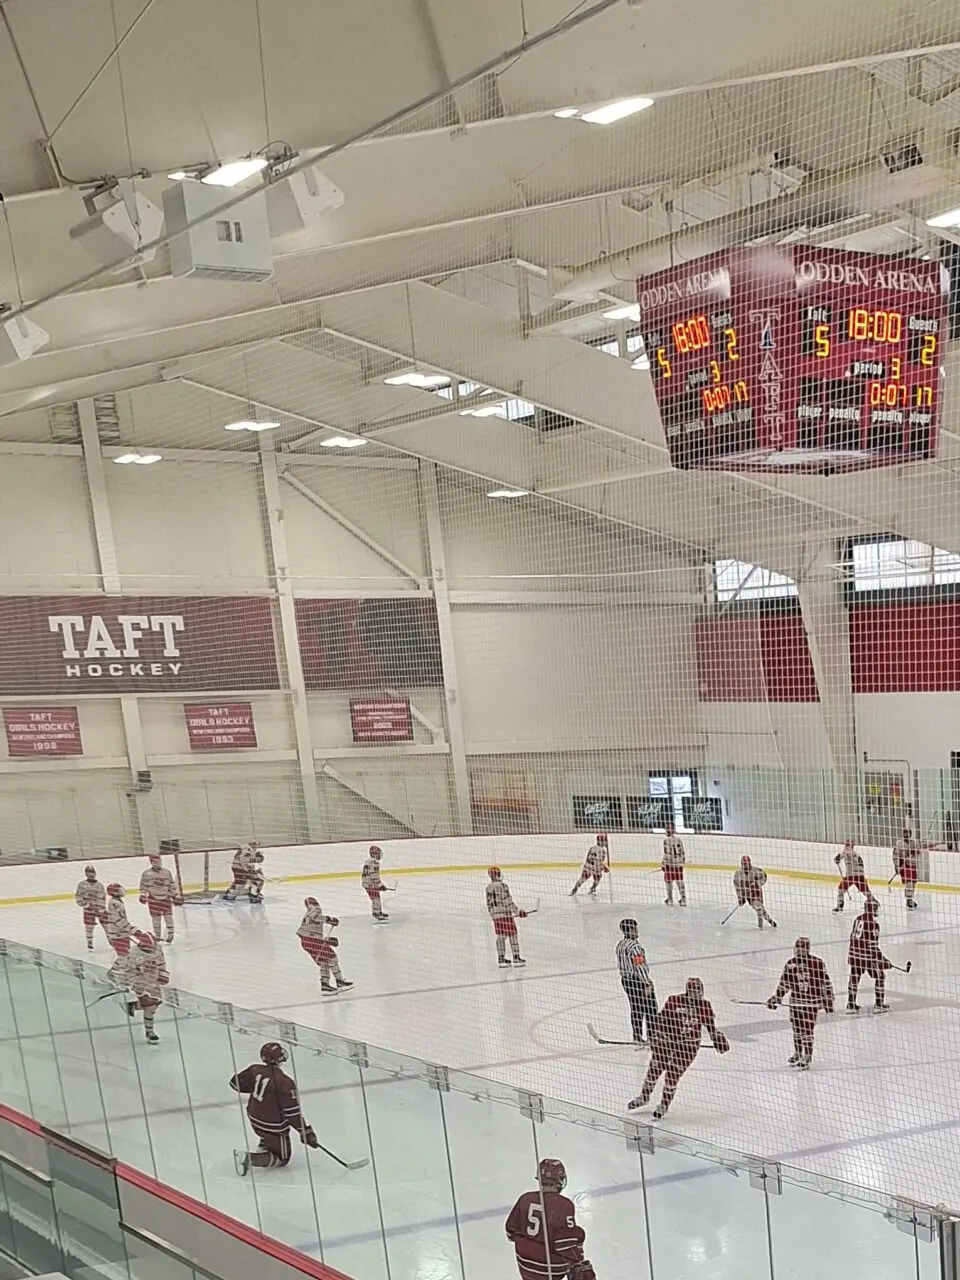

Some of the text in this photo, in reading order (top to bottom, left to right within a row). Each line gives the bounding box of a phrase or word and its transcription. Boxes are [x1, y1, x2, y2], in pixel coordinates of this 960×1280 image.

[800, 261, 937, 294] ODDEN ARENA
[641, 281, 683, 310] ODDEN
[671, 315, 711, 353] 18:00
[816, 325, 830, 357] 5
[848, 309, 901, 343] 18:00
[724, 328, 739, 360] 2
[921, 335, 936, 365] 2
[657, 348, 671, 378] 5
[748, 308, 785, 441] TAFT
[891, 357, 901, 379] 3
[703, 385, 730, 411] 0:07
[870, 383, 932, 407] 0:07 17
[48, 615, 185, 659] TAFT
[66, 663, 181, 677] HOCKEY
[29, 712, 53, 721] TAFT
[37, 723, 76, 731] HOCKEY
[208, 708, 229, 716] TAFT
[253, 1073, 270, 1102] 11
[526, 1203, 543, 1236] 5
